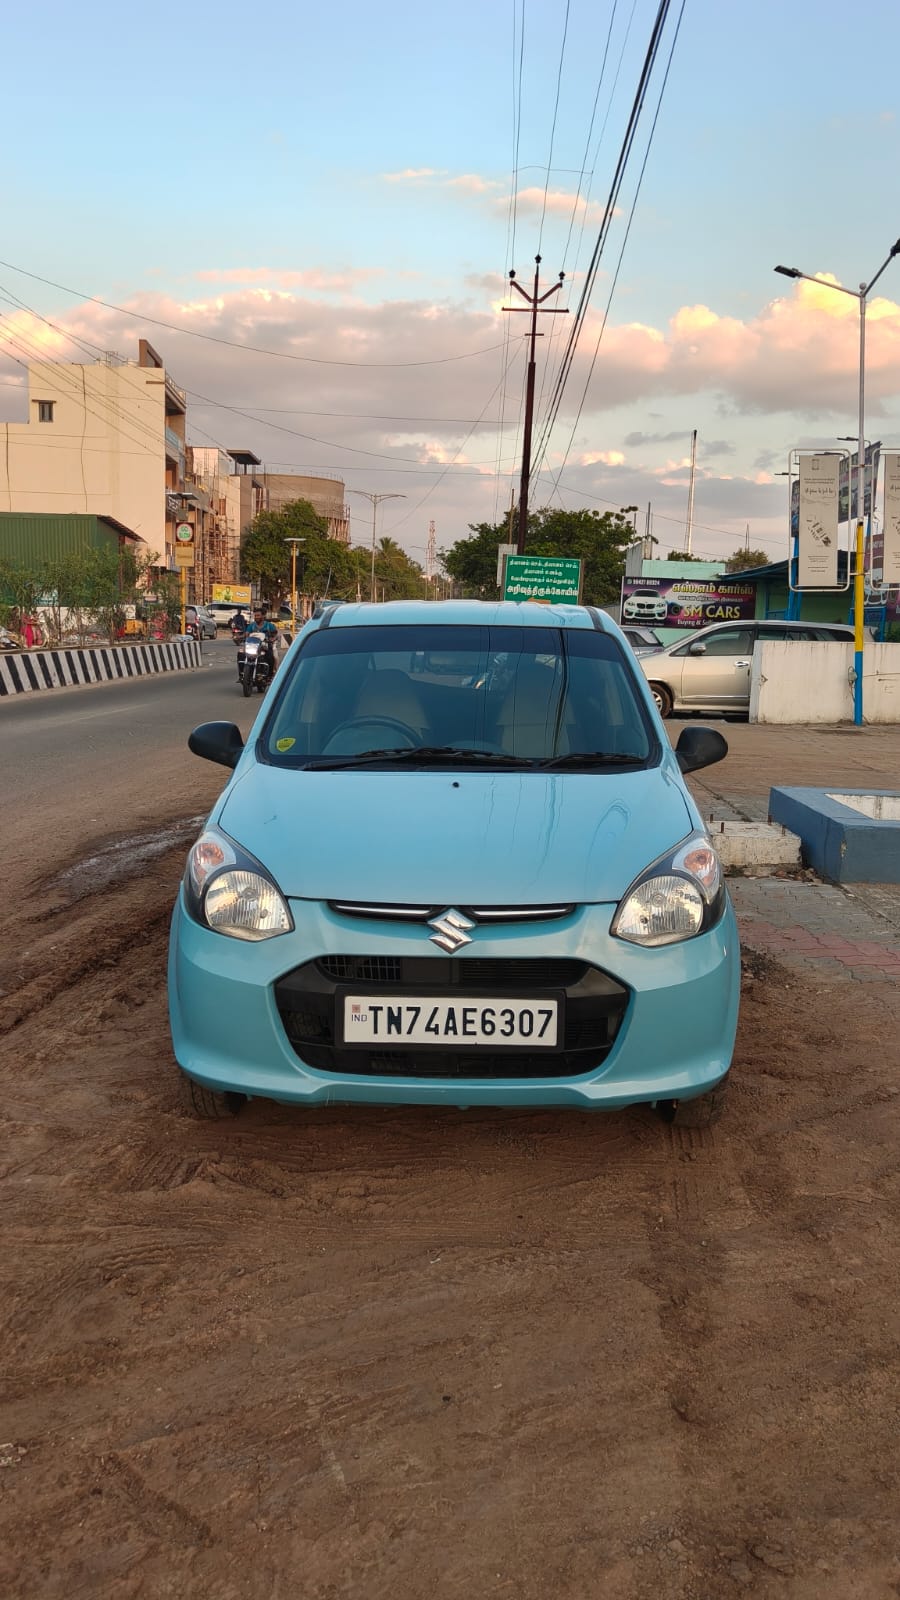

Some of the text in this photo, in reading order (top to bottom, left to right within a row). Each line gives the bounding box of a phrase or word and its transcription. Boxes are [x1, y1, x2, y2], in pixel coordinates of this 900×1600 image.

[684, 605, 740, 619] SM CARS
[351, 1014, 367, 1022] IND
[368, 1005, 553, 1038] TN74AE6307
